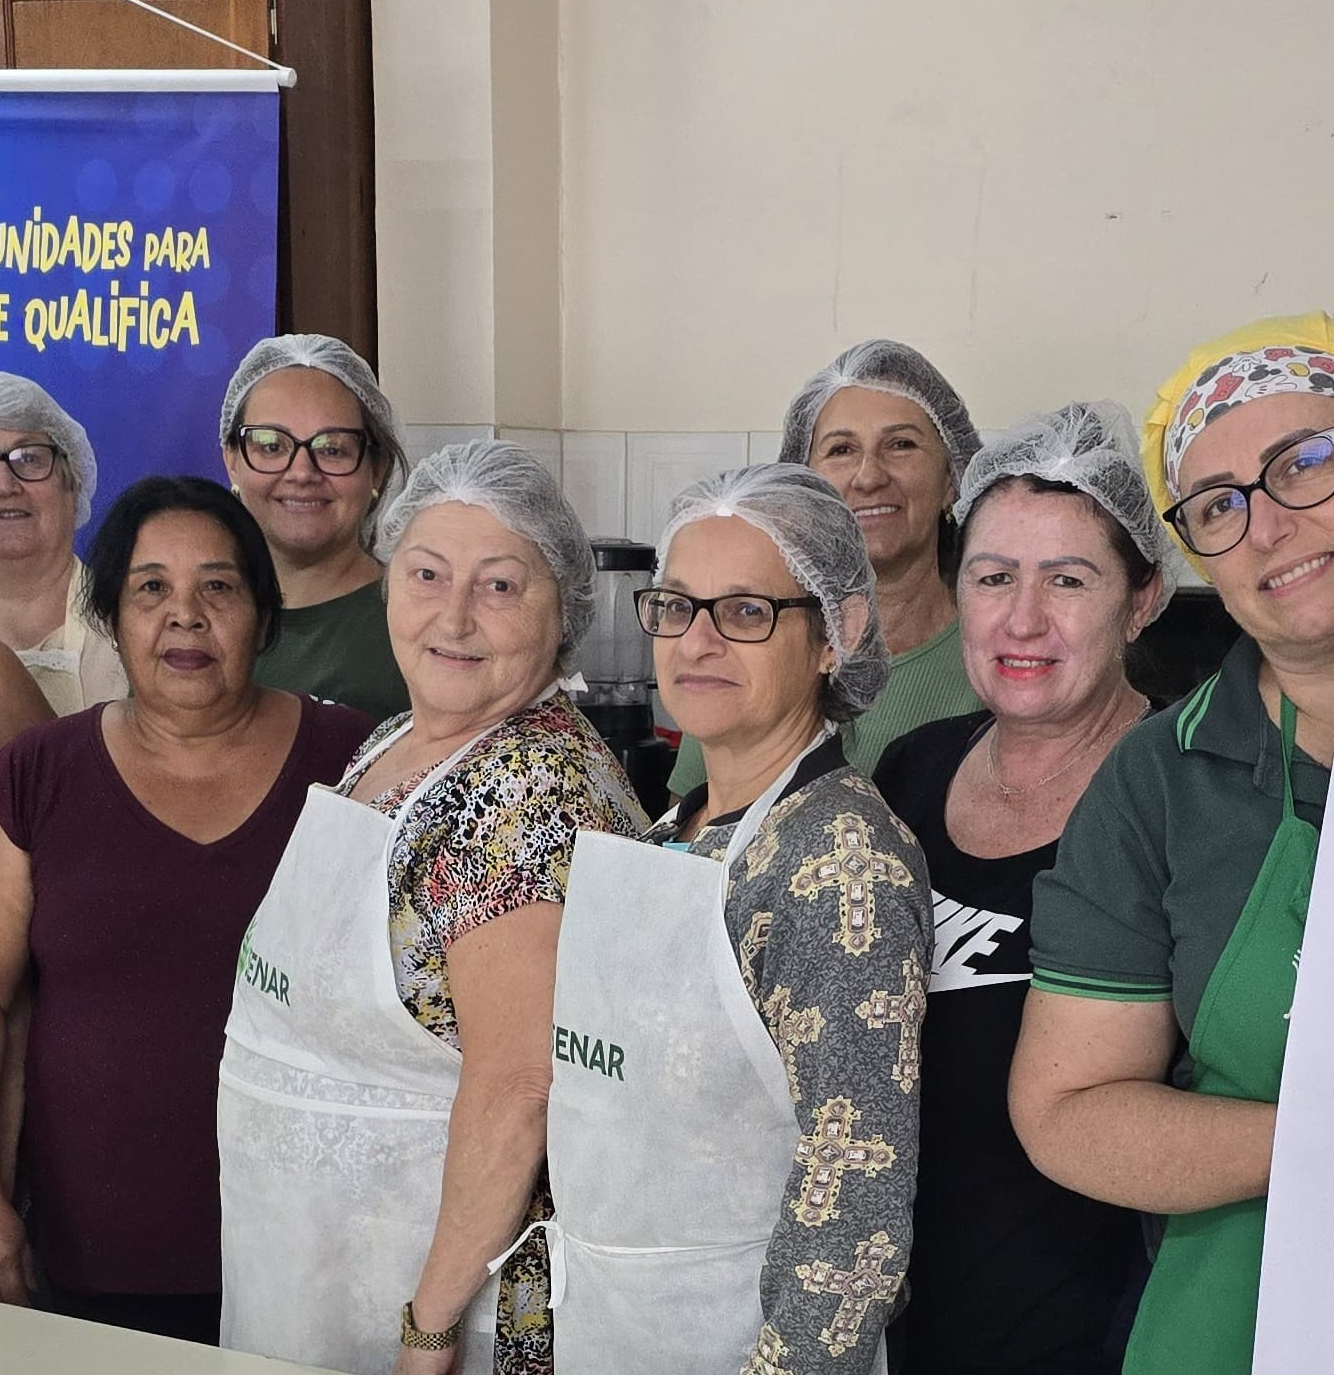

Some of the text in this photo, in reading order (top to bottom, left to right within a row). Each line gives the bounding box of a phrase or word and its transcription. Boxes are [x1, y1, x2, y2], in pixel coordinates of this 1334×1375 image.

[144, 227, 210, 274] PARA
[245, 948, 291, 1007] ENAR
[553, 1023, 625, 1081] ENAR
